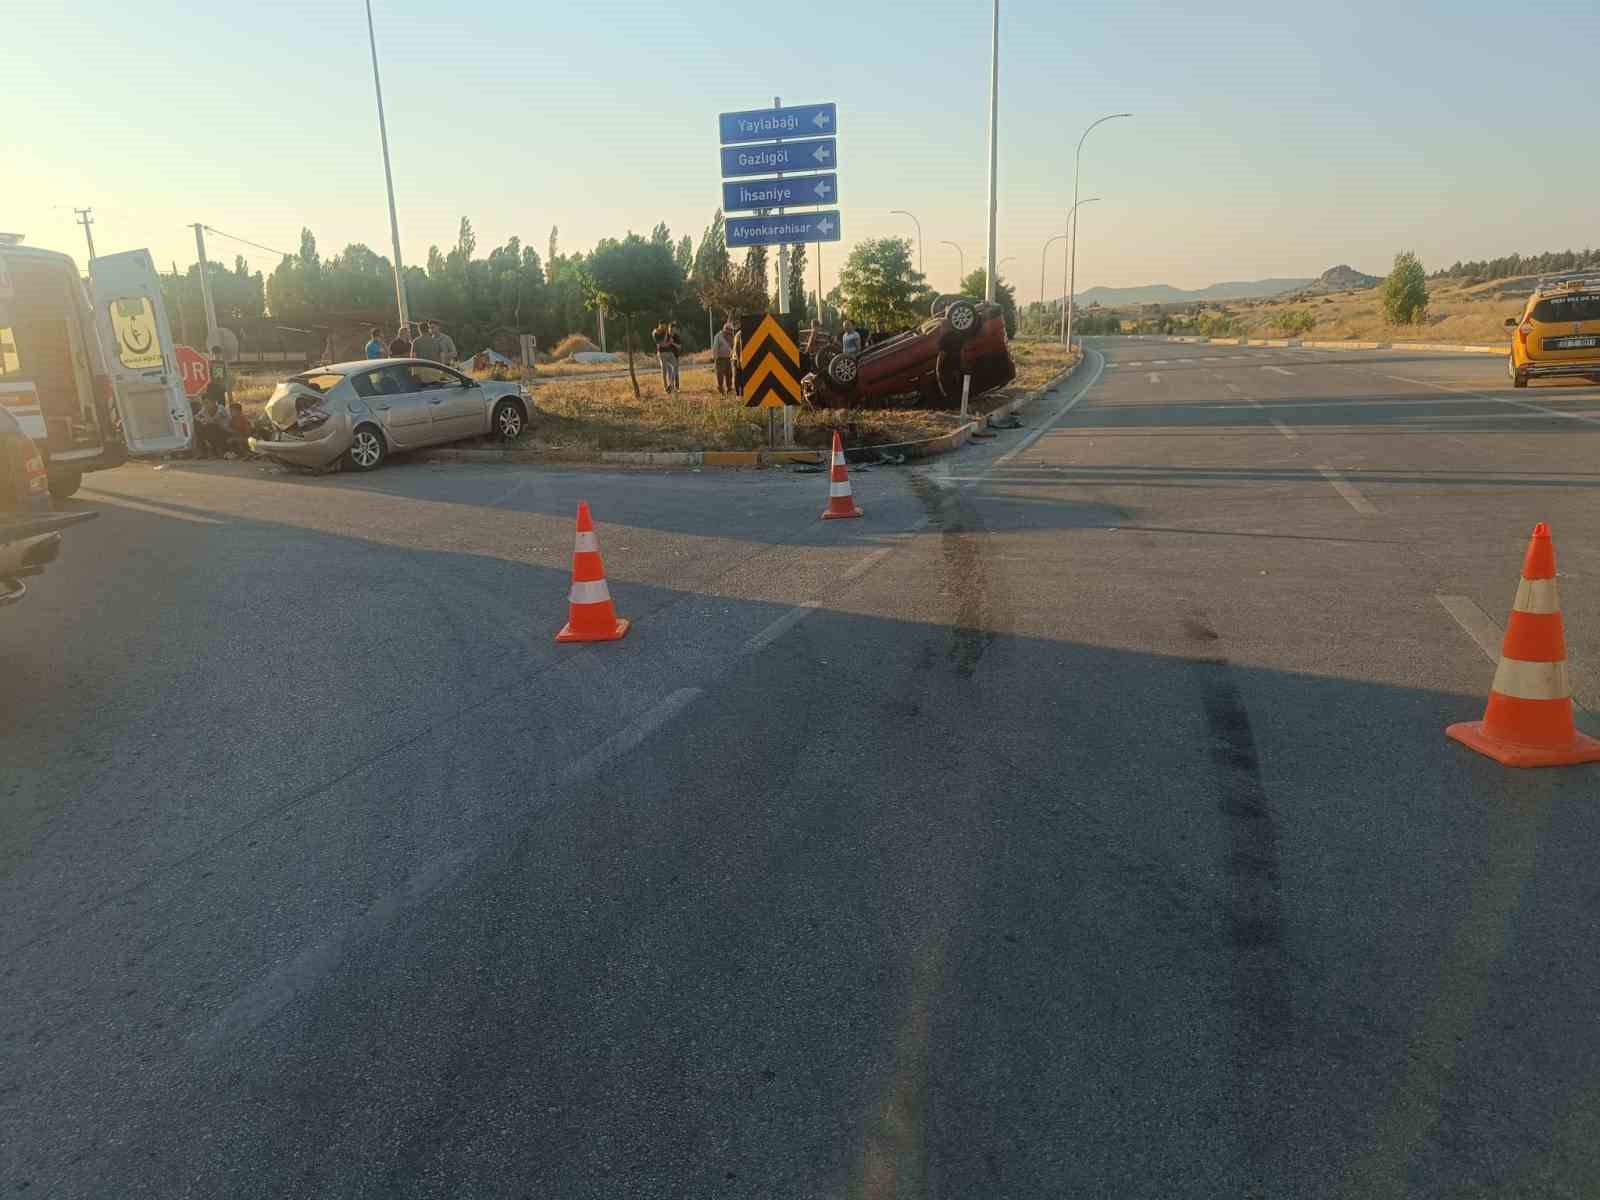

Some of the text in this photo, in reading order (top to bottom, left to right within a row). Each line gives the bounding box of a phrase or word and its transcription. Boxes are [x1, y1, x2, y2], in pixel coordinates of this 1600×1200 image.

[738, 115, 799, 133] Yaylabağı
[738, 150, 789, 166] Gazlıgöl
[740, 187, 791, 202] İhsaniye
[734, 223, 812, 239] Afyonkarahisar
